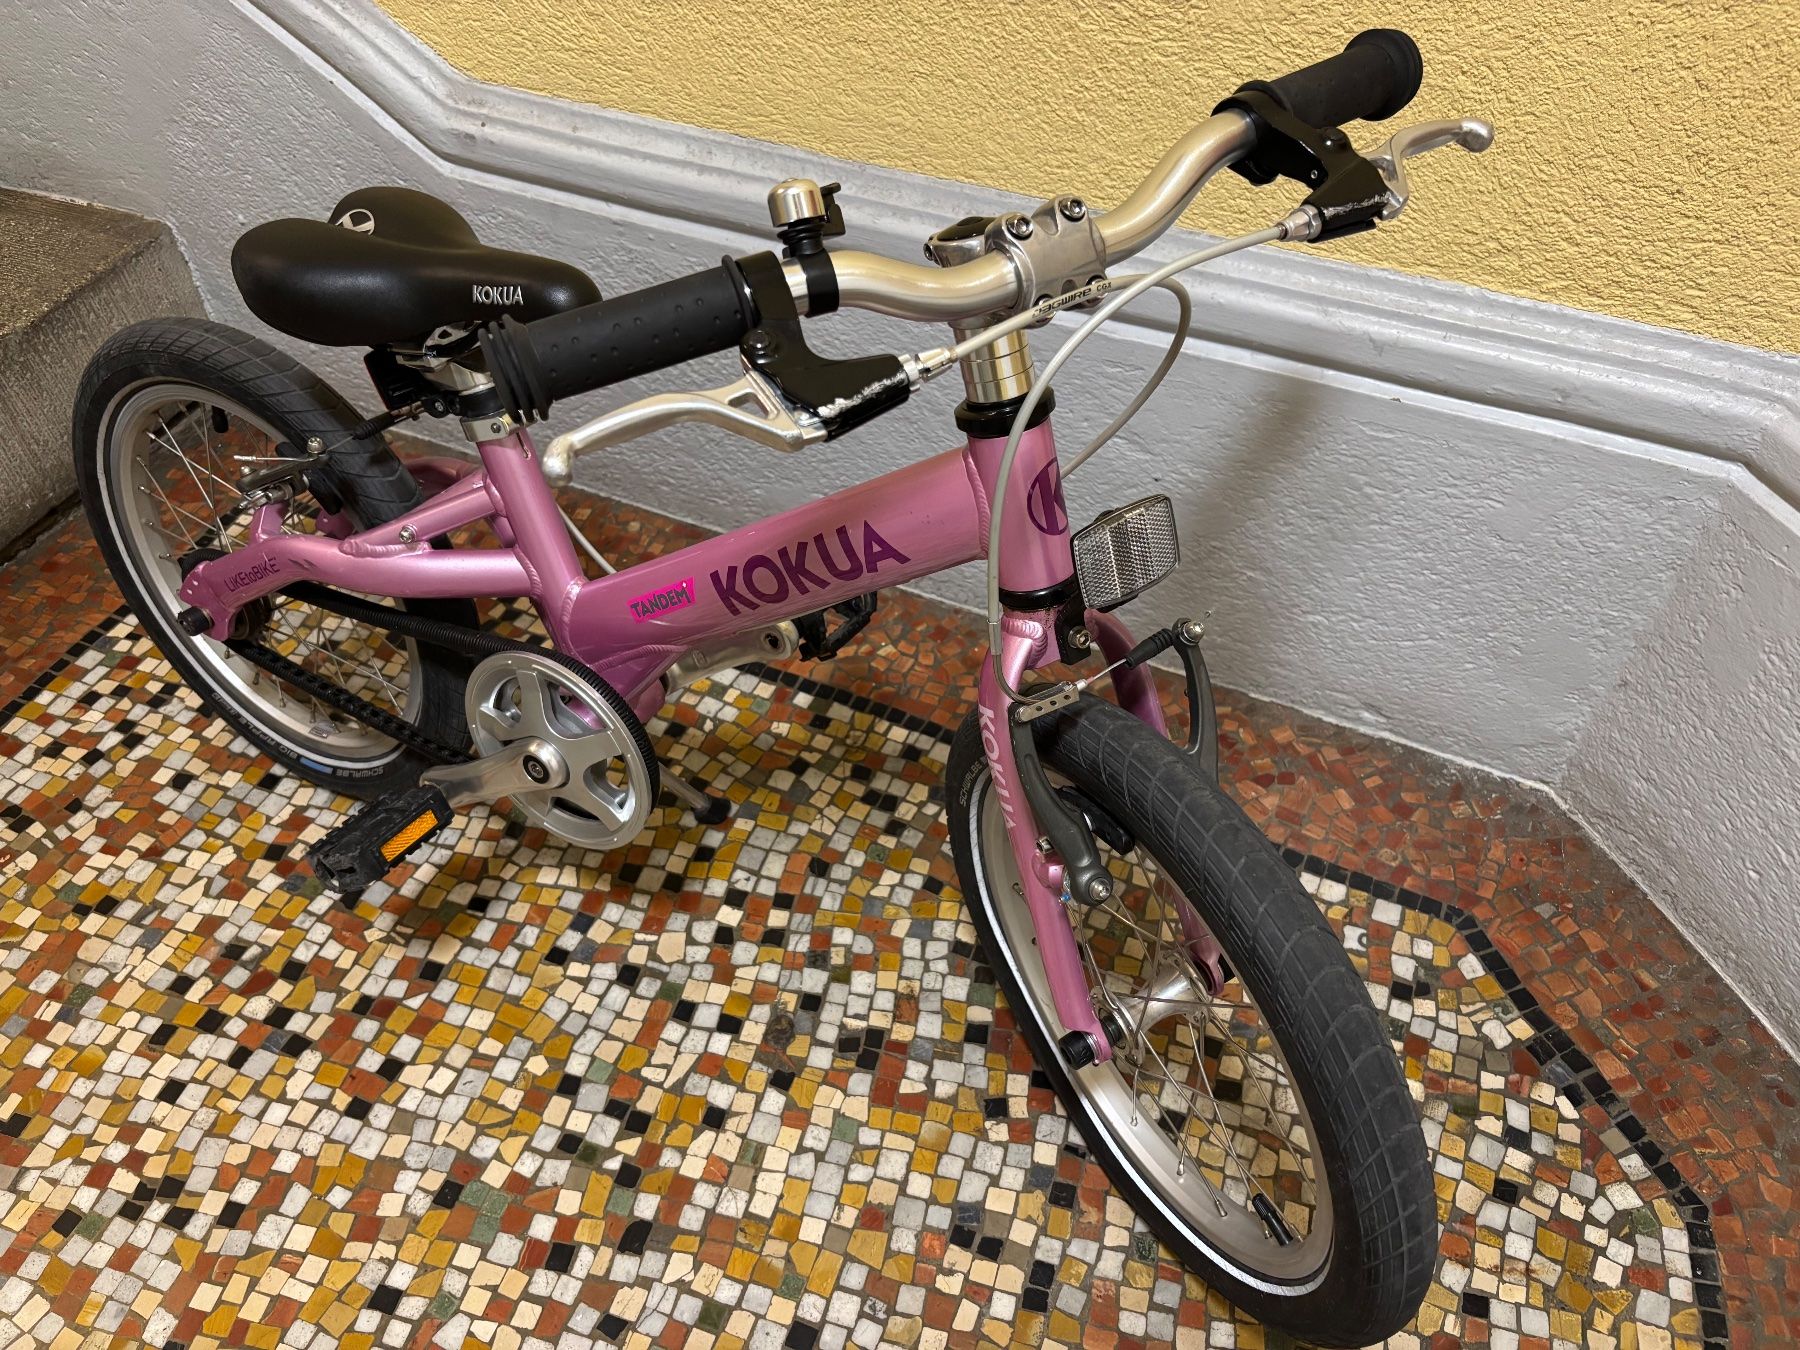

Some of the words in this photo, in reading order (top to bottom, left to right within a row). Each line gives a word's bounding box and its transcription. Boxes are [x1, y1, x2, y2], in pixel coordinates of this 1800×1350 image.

[472, 284, 524, 306] KOKUA
[709, 519, 911, 617] KOKUA
[630, 586, 692, 618] TANDEM
[335, 766, 384, 778] SCHWALBE
[959, 761, 982, 808] SCHWALBE
